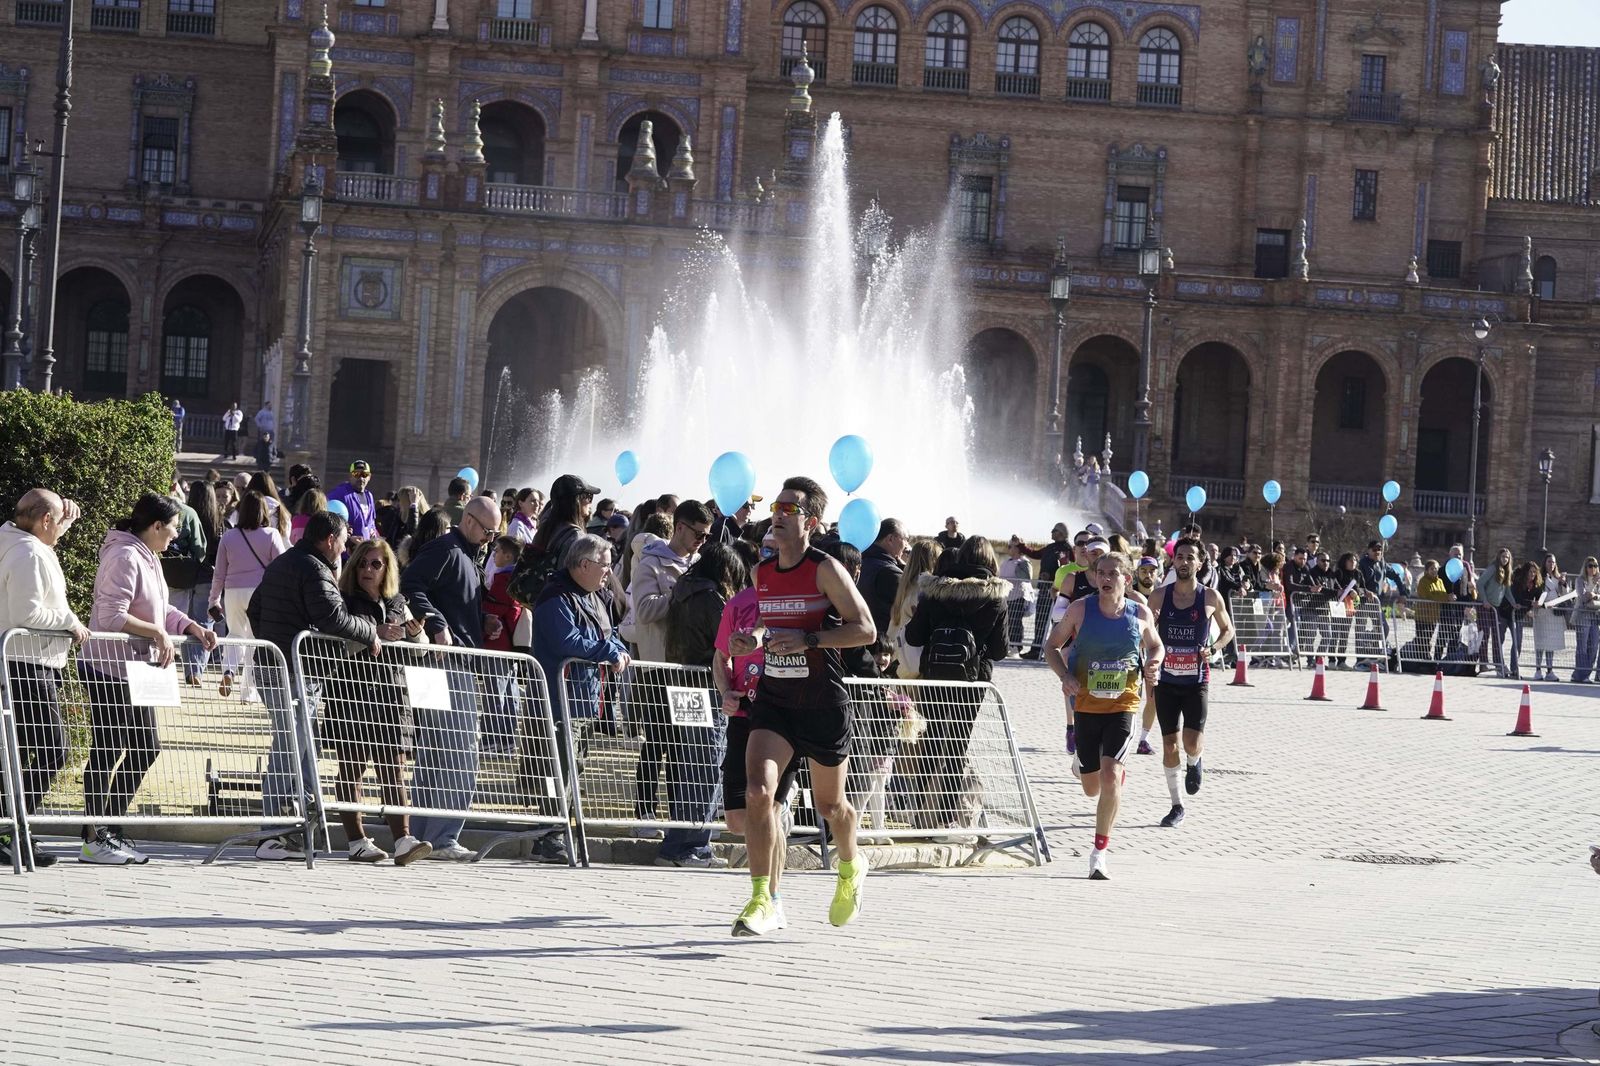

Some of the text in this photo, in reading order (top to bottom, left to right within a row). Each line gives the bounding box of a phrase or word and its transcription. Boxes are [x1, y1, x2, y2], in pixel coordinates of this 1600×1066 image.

[1168, 627, 1195, 636] STADE
[765, 654, 807, 666] BEJARANO
[1174, 662, 1198, 670] GAUCHO
[1096, 681, 1120, 690] ROBIN
